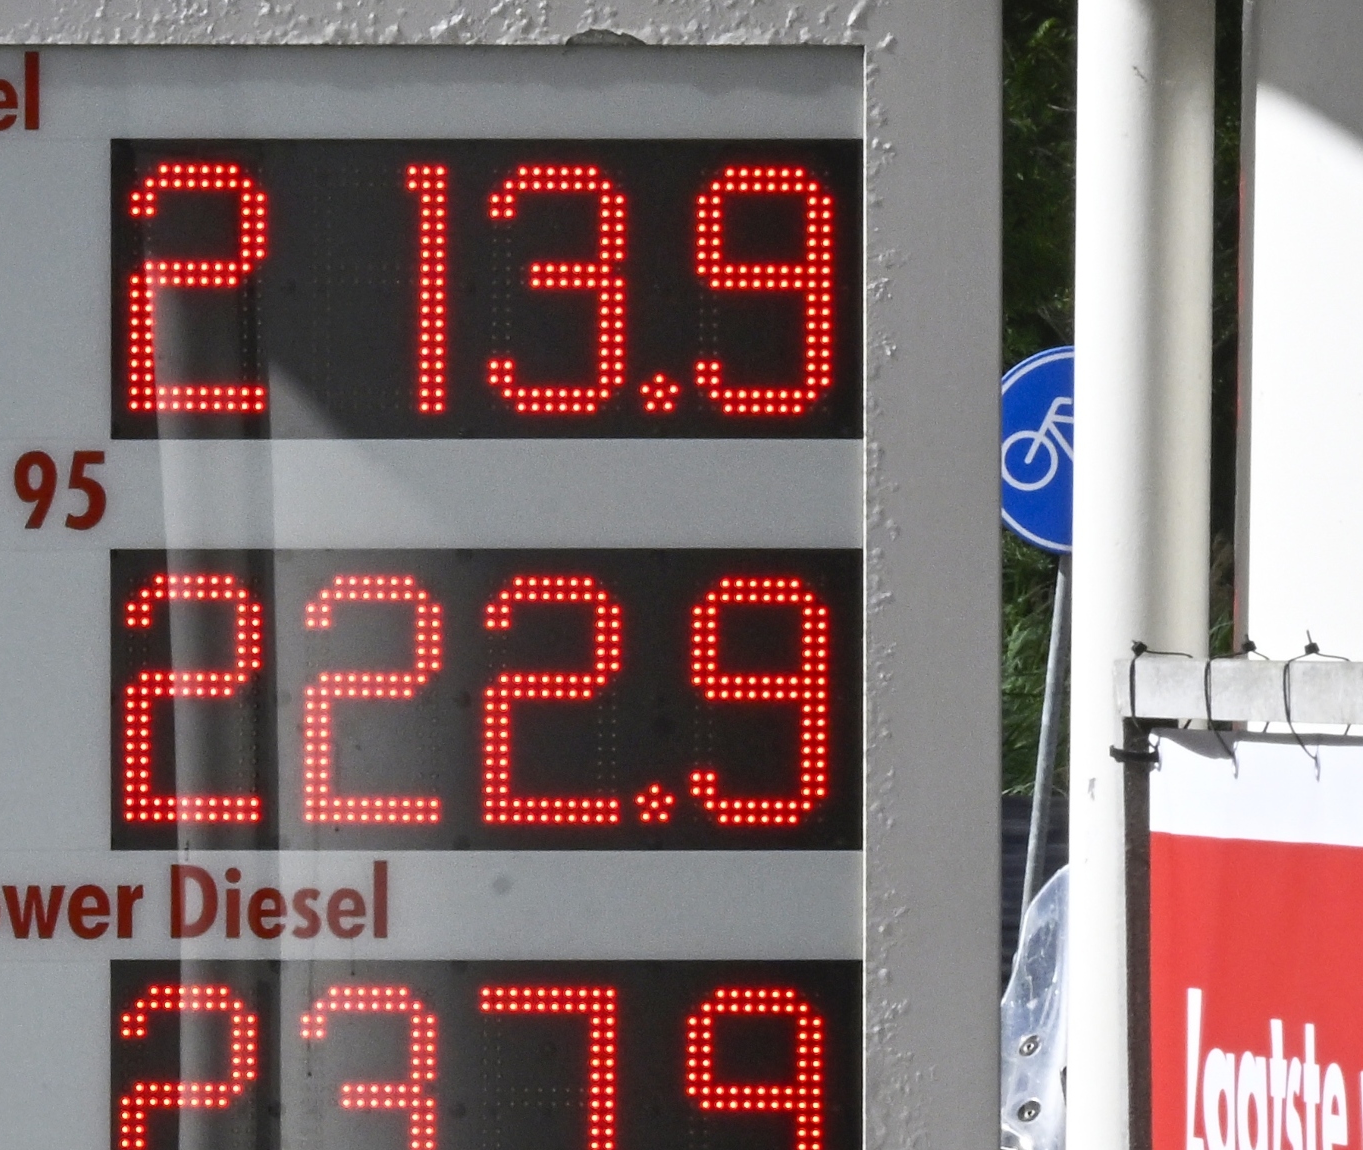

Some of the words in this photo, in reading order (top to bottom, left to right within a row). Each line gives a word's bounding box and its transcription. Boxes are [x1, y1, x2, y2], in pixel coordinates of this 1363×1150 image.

[125, 159, 838, 419] 213.9
[14, 450, 106, 530] 95
[120, 571, 833, 829] 222.9
[170, 863, 387, 939] Diesel
